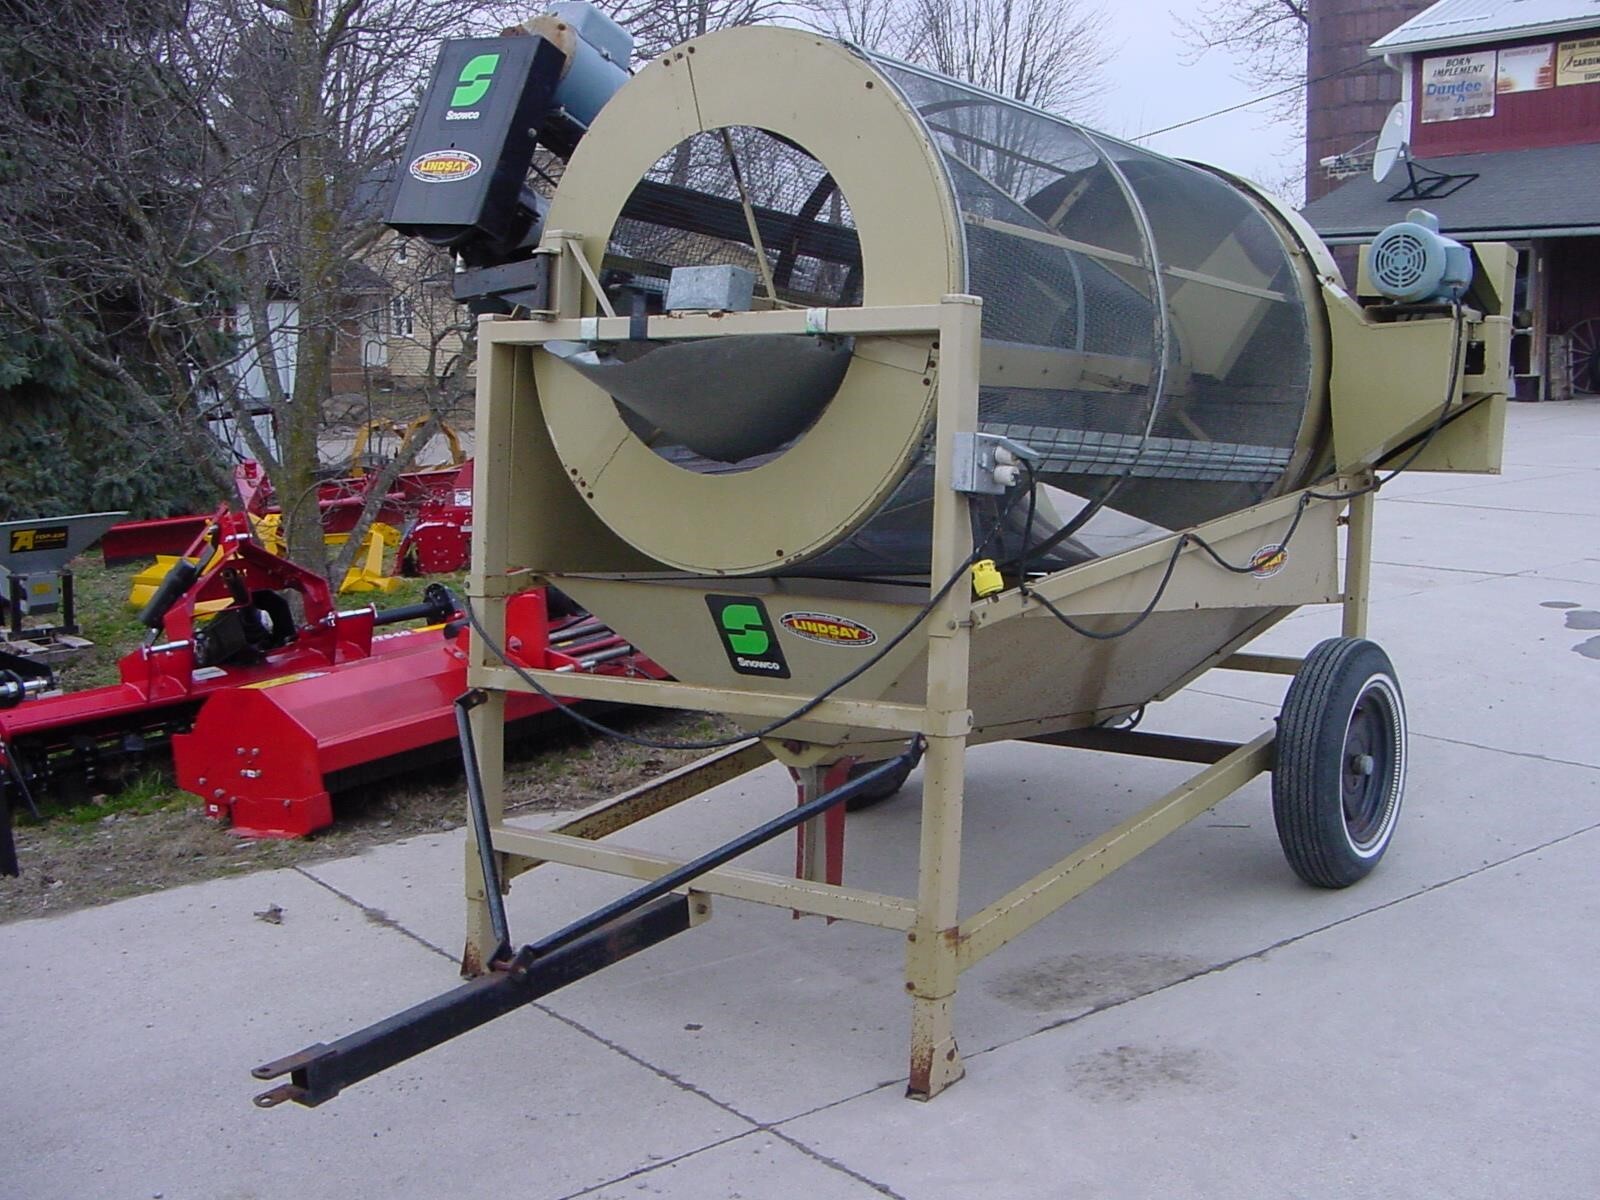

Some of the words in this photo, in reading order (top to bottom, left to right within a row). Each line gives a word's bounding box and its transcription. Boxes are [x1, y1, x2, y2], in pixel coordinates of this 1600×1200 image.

[1446, 56, 1472, 68] BORN
[1432, 64, 1485, 77] IMPLEMENT
[1426, 81, 1482, 96] Dundee
[446, 110, 480, 120] Snowco
[420, 161, 468, 172] LINDSAY
[792, 618, 860, 639] LINDSAY
[737, 657, 780, 670] Snowco
